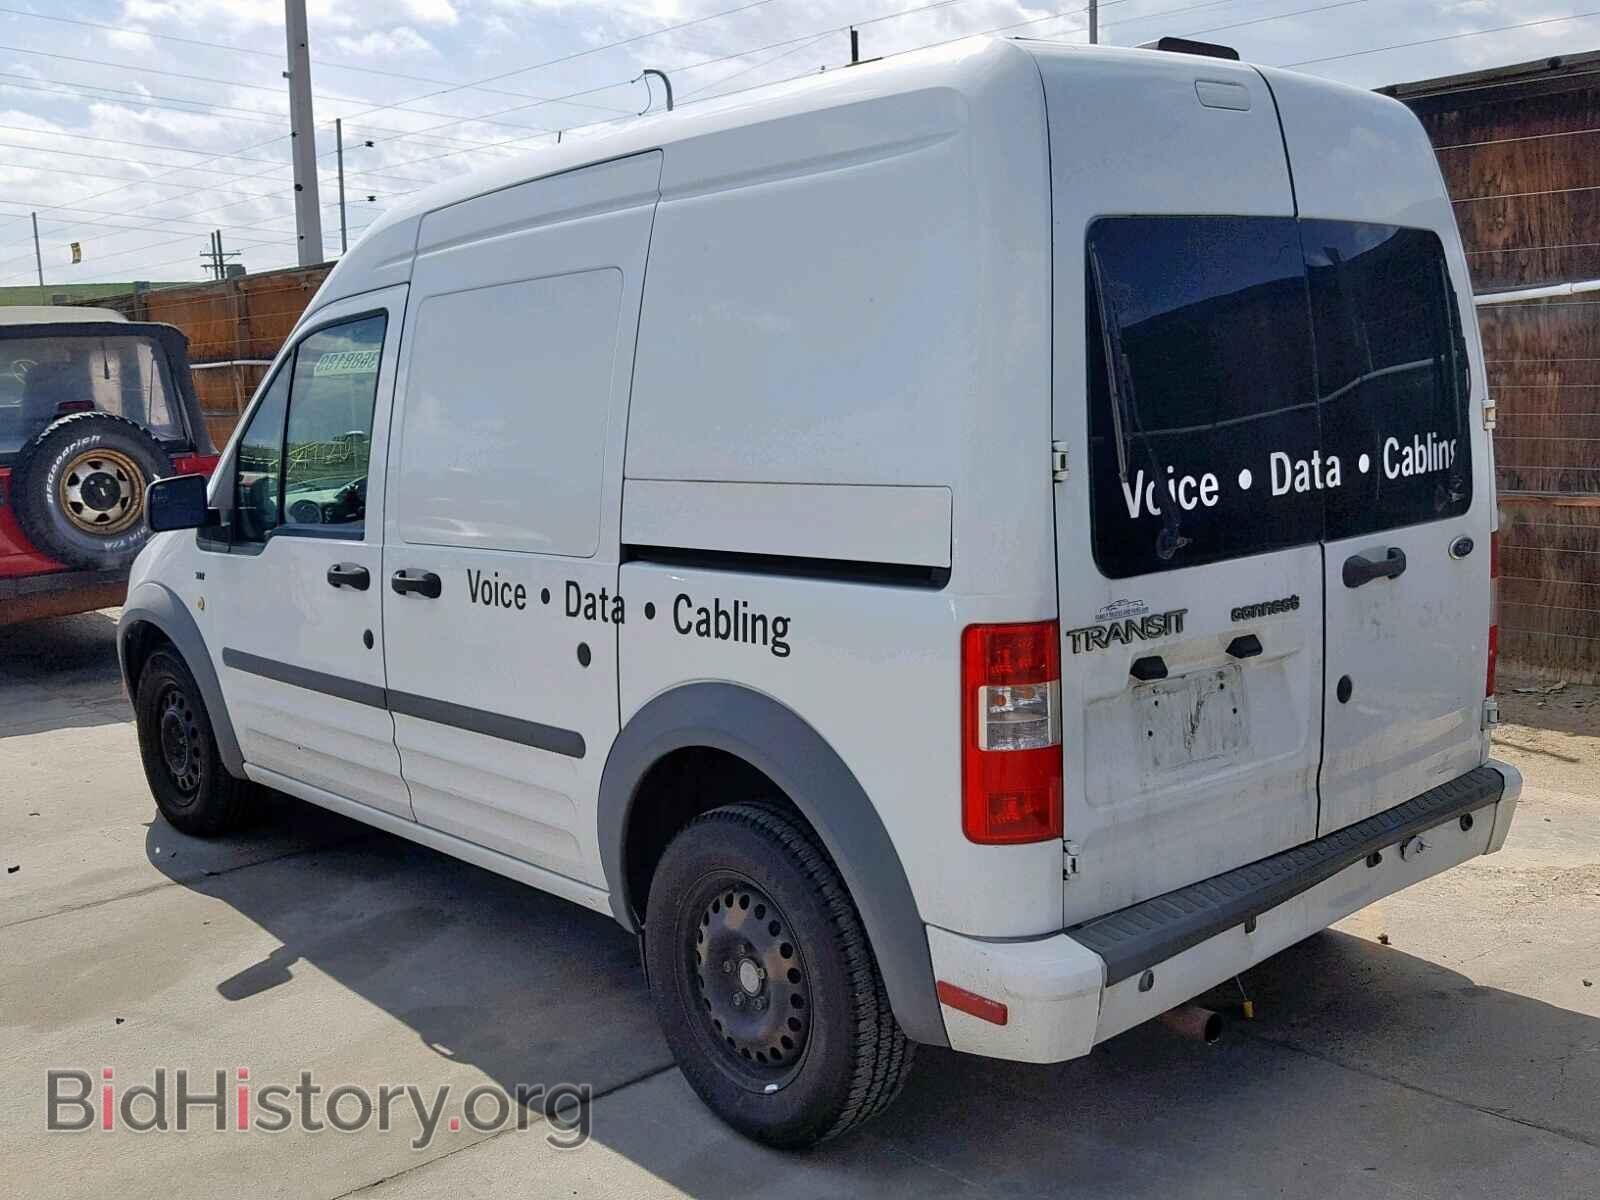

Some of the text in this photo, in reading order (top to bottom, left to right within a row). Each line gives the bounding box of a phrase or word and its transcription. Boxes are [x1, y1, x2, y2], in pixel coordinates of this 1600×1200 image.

[46, 435, 101, 504] BFGoodrich
[1270, 450, 1342, 496] Data
[466, 568, 791, 658] Voice Data Cabling
[1066, 608, 1188, 654] TRANSIT
